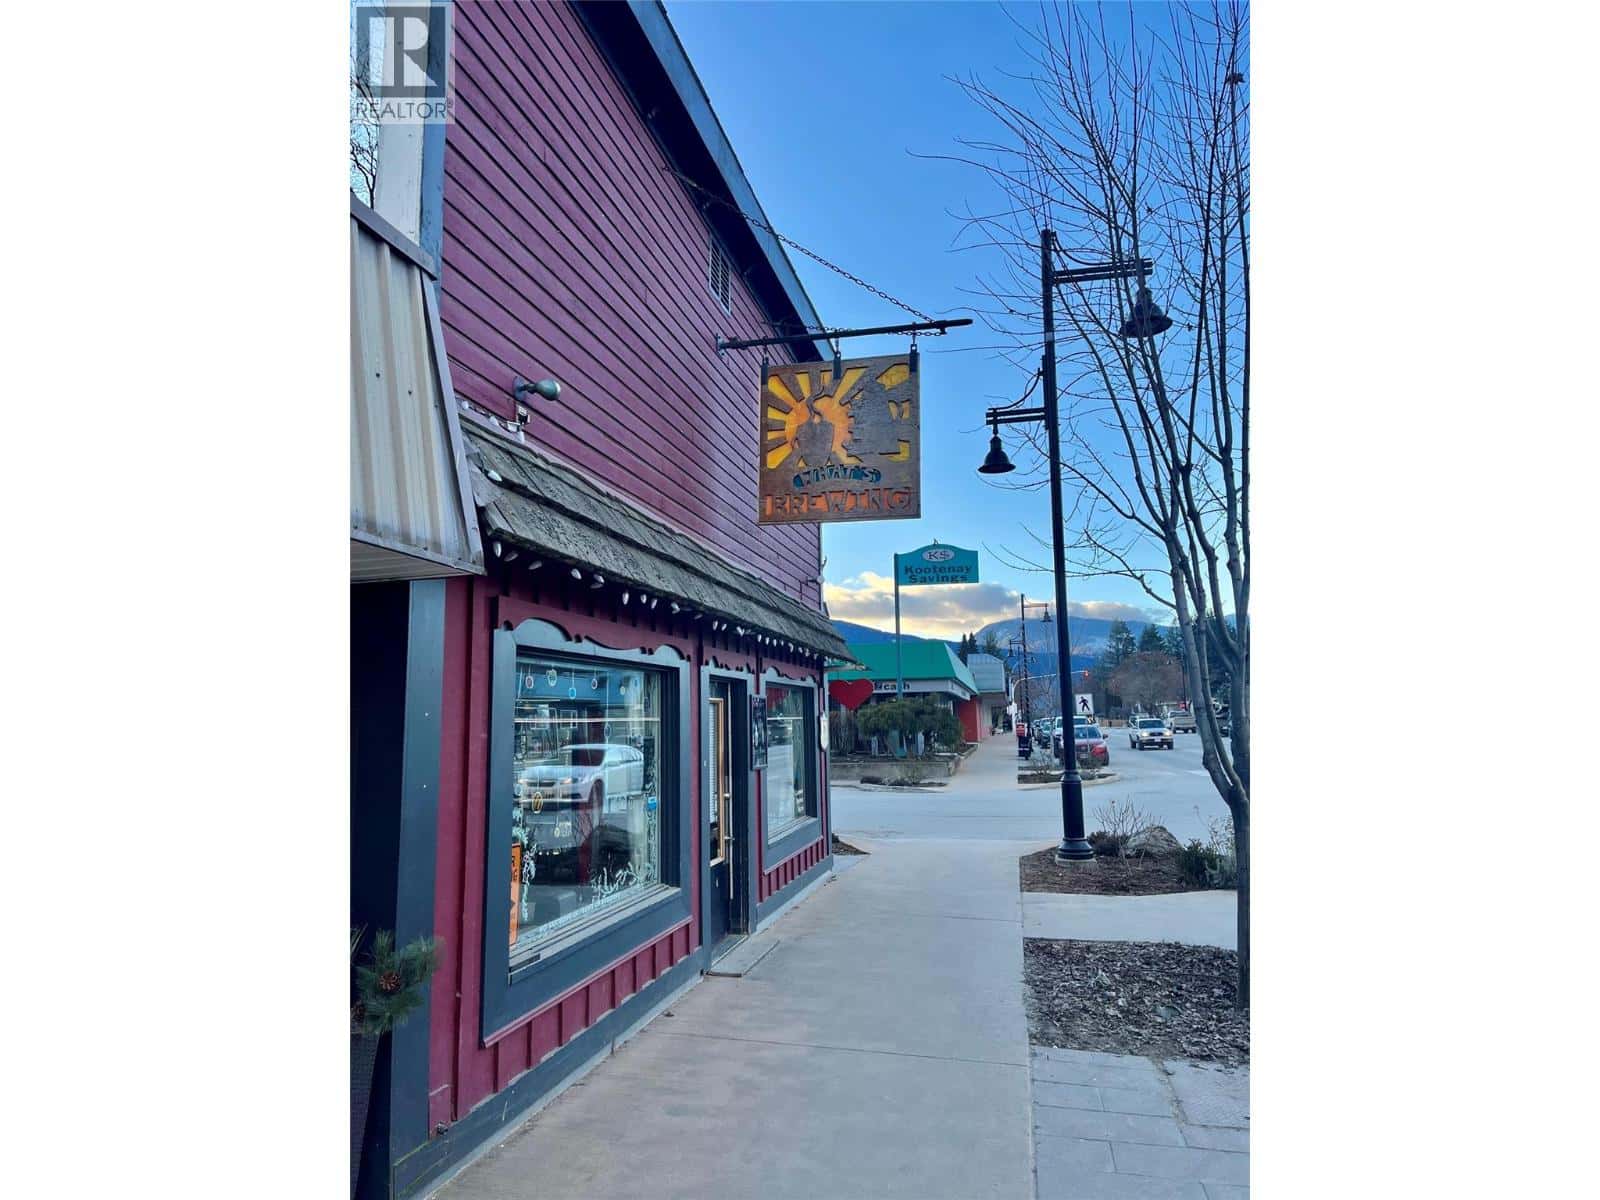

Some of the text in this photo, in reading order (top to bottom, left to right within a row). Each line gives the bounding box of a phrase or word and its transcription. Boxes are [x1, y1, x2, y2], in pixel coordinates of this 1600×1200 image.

[768, 488, 911, 516] BREWING
[905, 564, 973, 575] Kootenay
[909, 574, 969, 584] Savings
